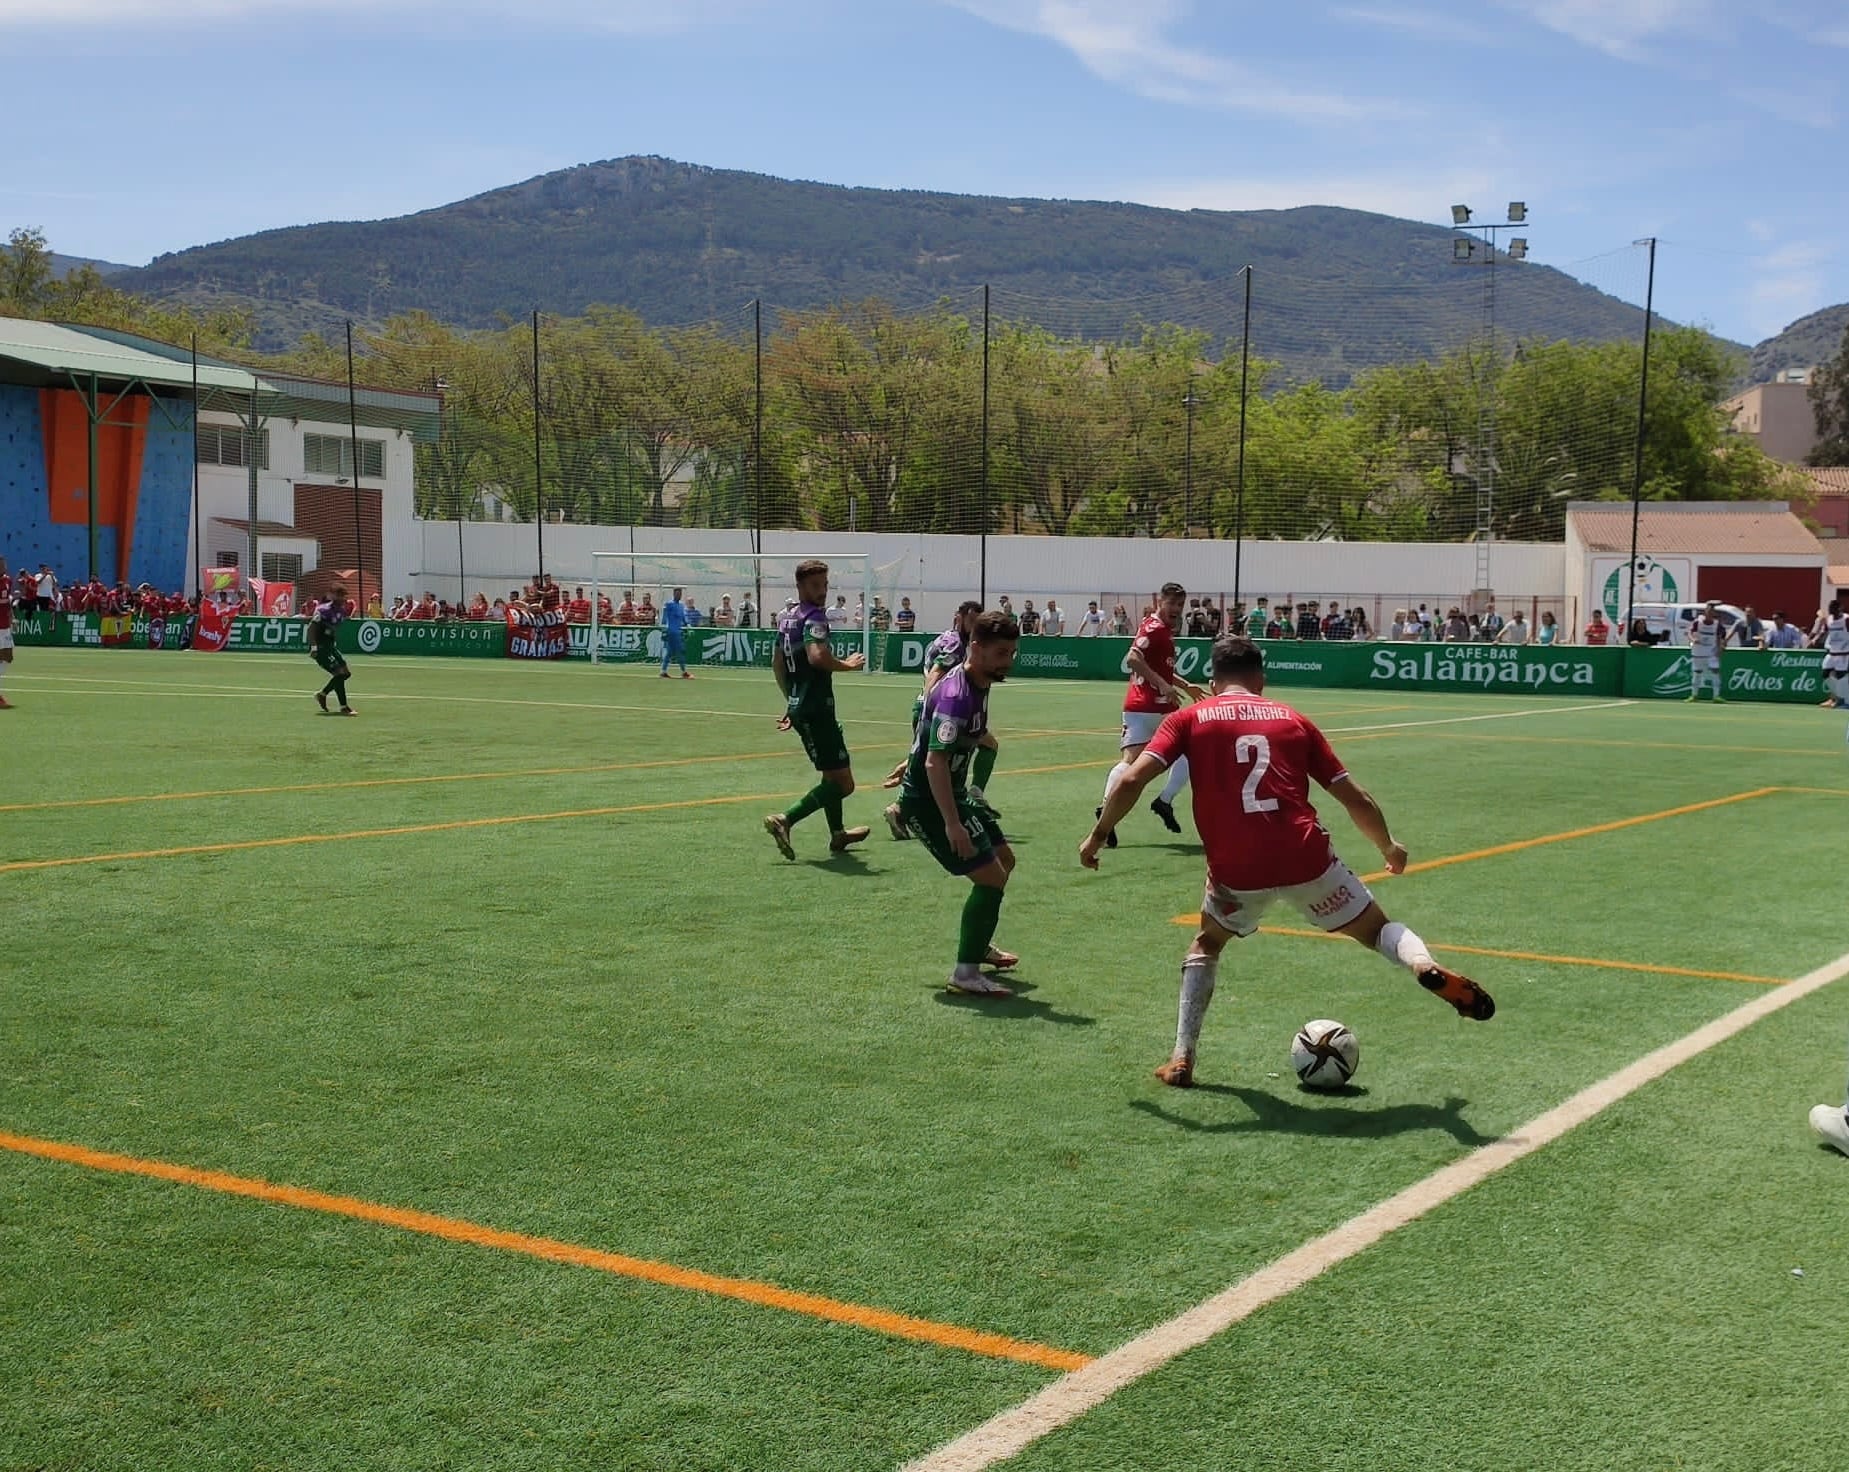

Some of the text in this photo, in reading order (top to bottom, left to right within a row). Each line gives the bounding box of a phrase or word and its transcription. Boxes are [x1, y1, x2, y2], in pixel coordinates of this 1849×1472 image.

[382, 626, 491, 640] eurovision
[1370, 649, 1594, 689] Salamanca
[1728, 667, 1784, 691] Aires
[1790, 670, 1817, 692] de
[1196, 705, 1236, 724] MARIO
[1235, 734, 1280, 814] 2
